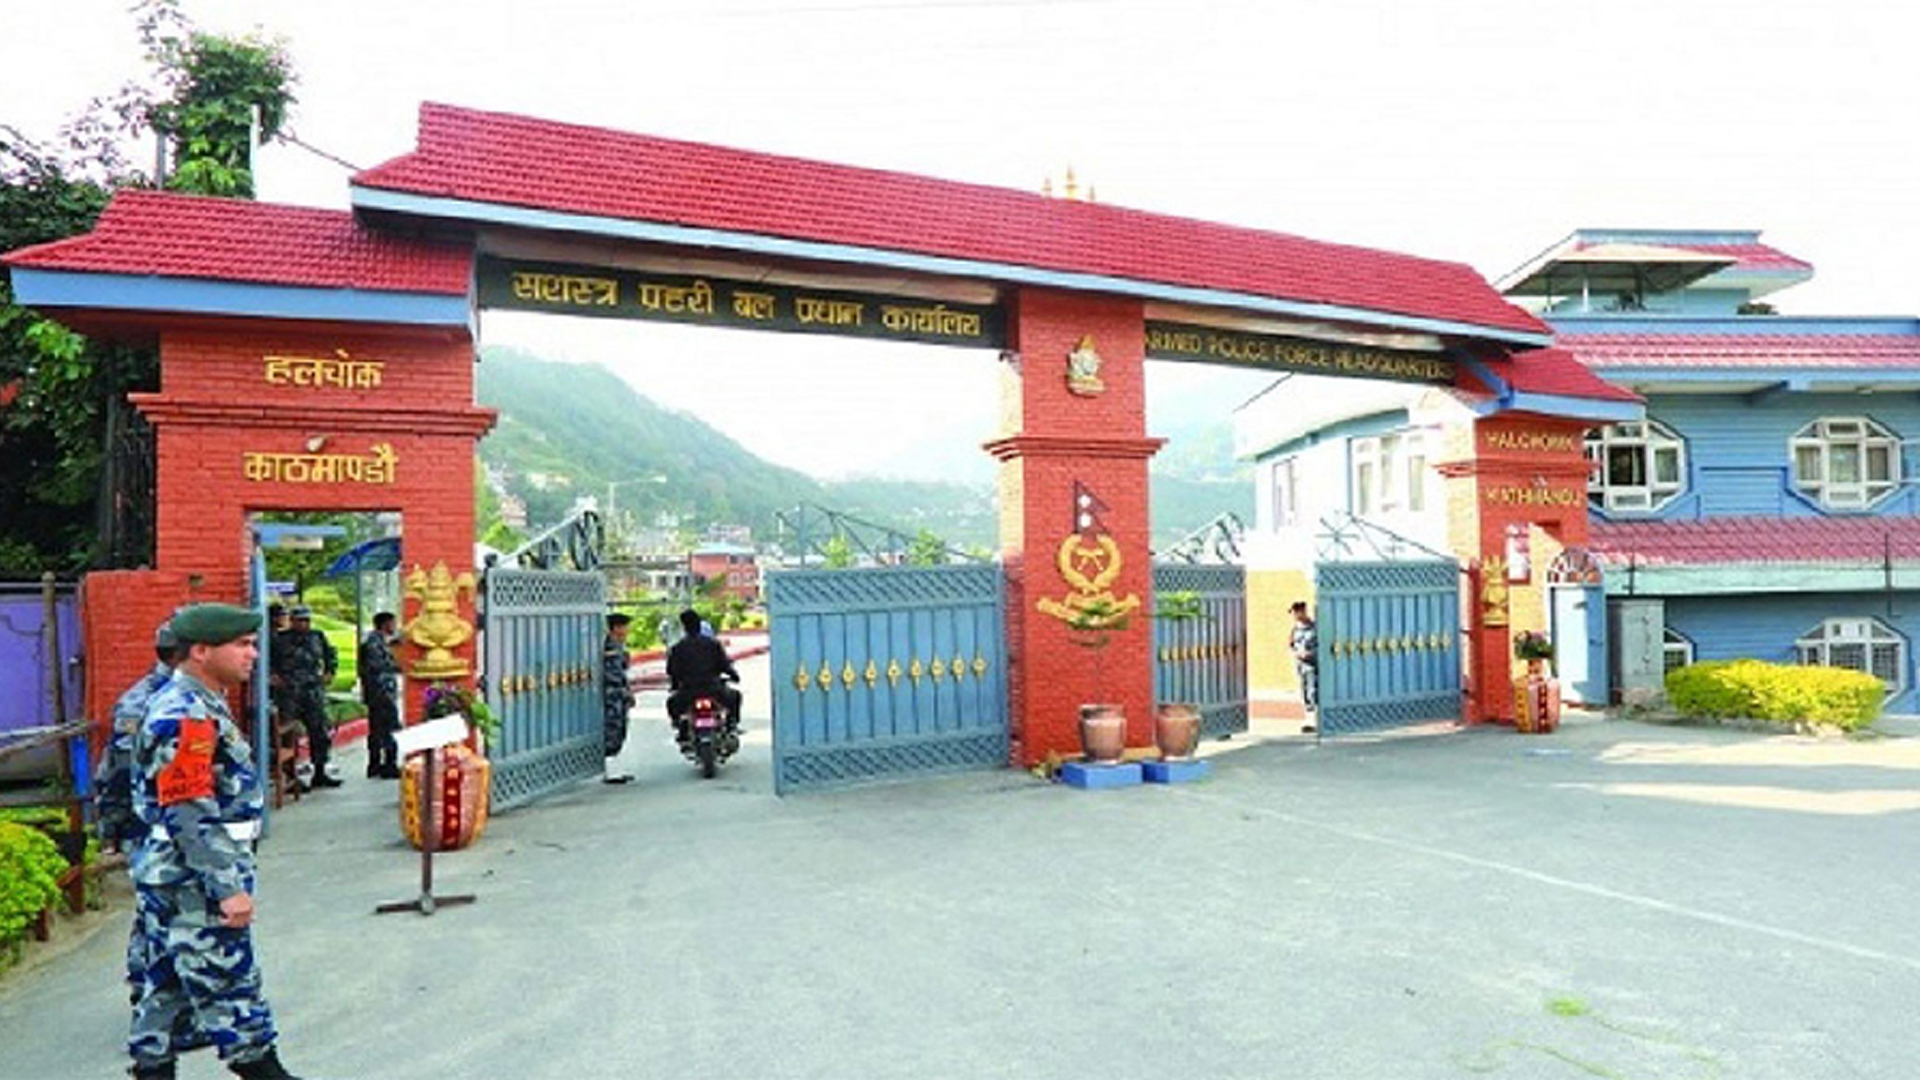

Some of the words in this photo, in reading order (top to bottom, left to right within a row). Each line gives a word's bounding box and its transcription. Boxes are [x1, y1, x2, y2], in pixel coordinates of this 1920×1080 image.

[639, 280, 713, 314] प्रहरी
[733, 292, 774, 319] बल
[795, 299, 862, 325] प्रधान
[882, 303, 980, 336] कार्यालय
[263, 349, 385, 388] हलचोक
[1208, 336, 1269, 361] POLICE
[1275, 345, 1328, 367] FORCE
[243, 443, 398, 483] काठमाण्डौ
[1486, 486, 1581, 507] KATHMANDU
